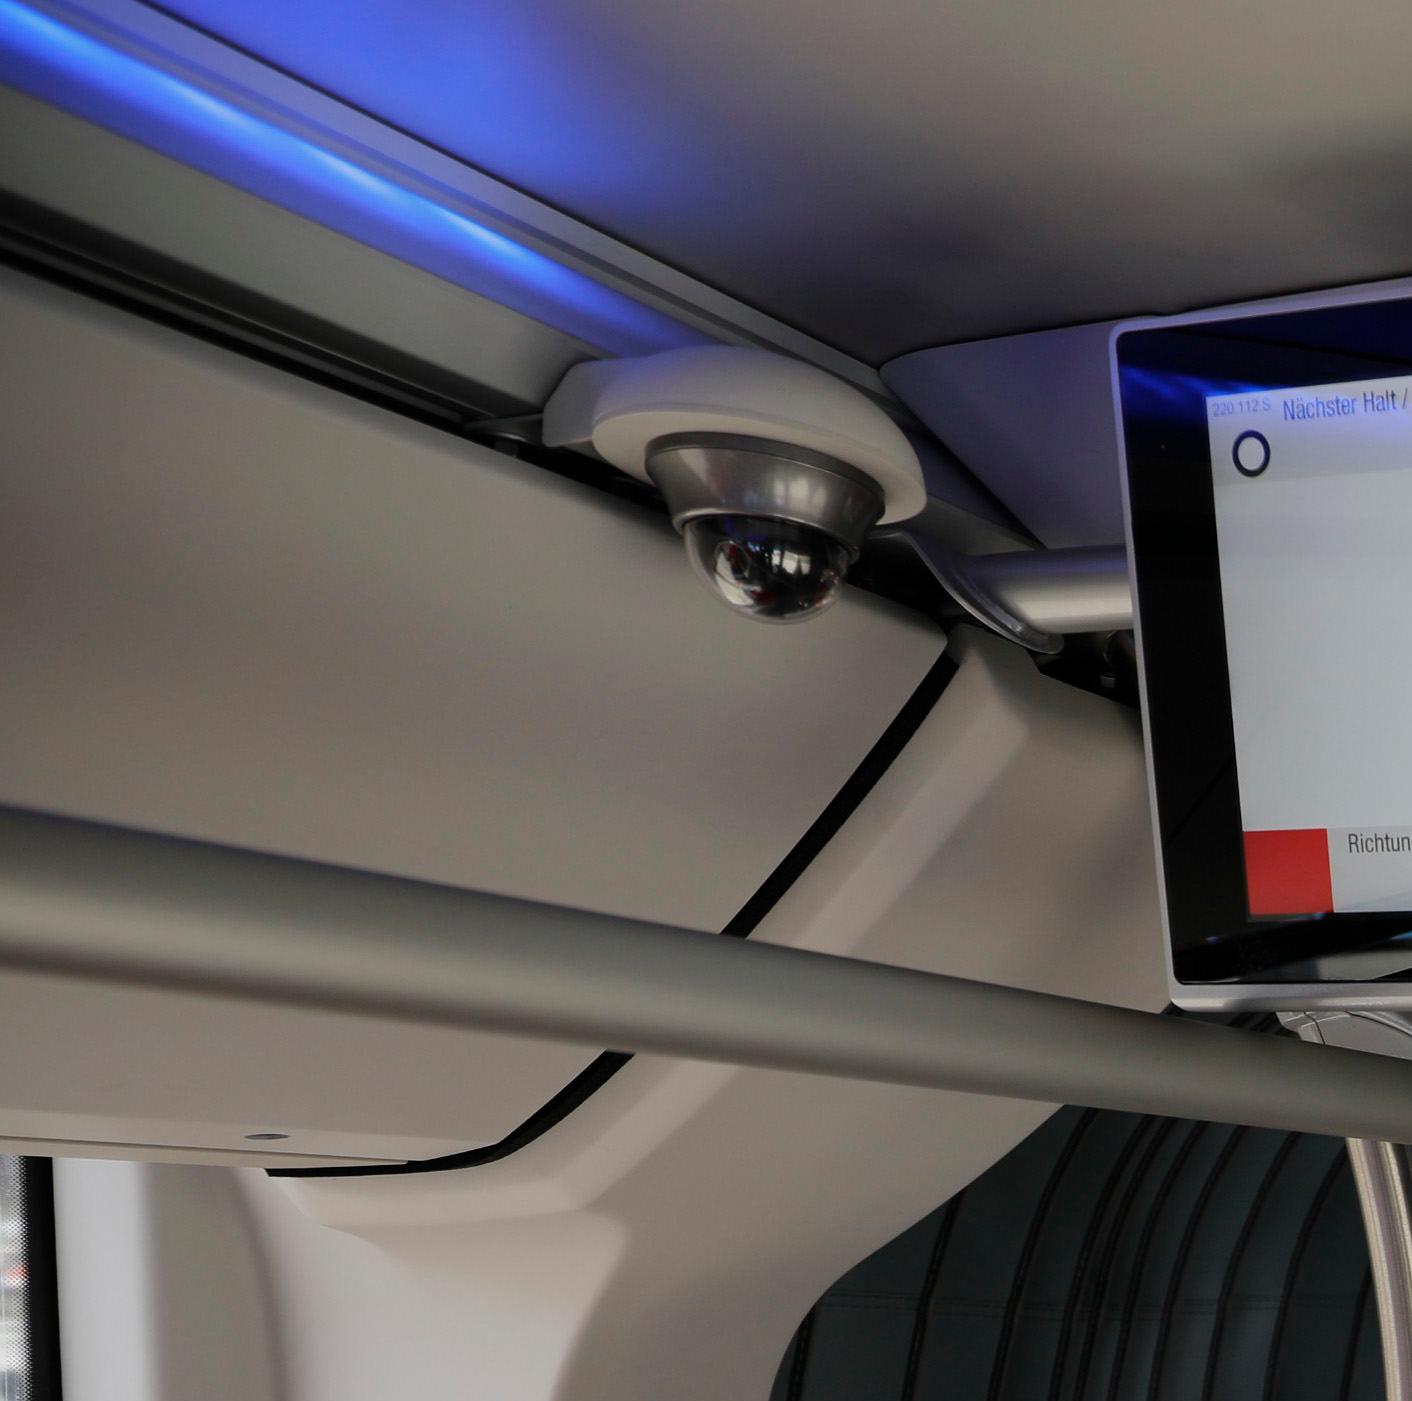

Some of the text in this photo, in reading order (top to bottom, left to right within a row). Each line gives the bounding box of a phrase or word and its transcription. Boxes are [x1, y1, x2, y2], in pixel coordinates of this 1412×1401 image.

[1282, 392, 1358, 421] Nächster
[1364, 389, 1397, 413] Halt
[1401, 388, 1409, 410] /
